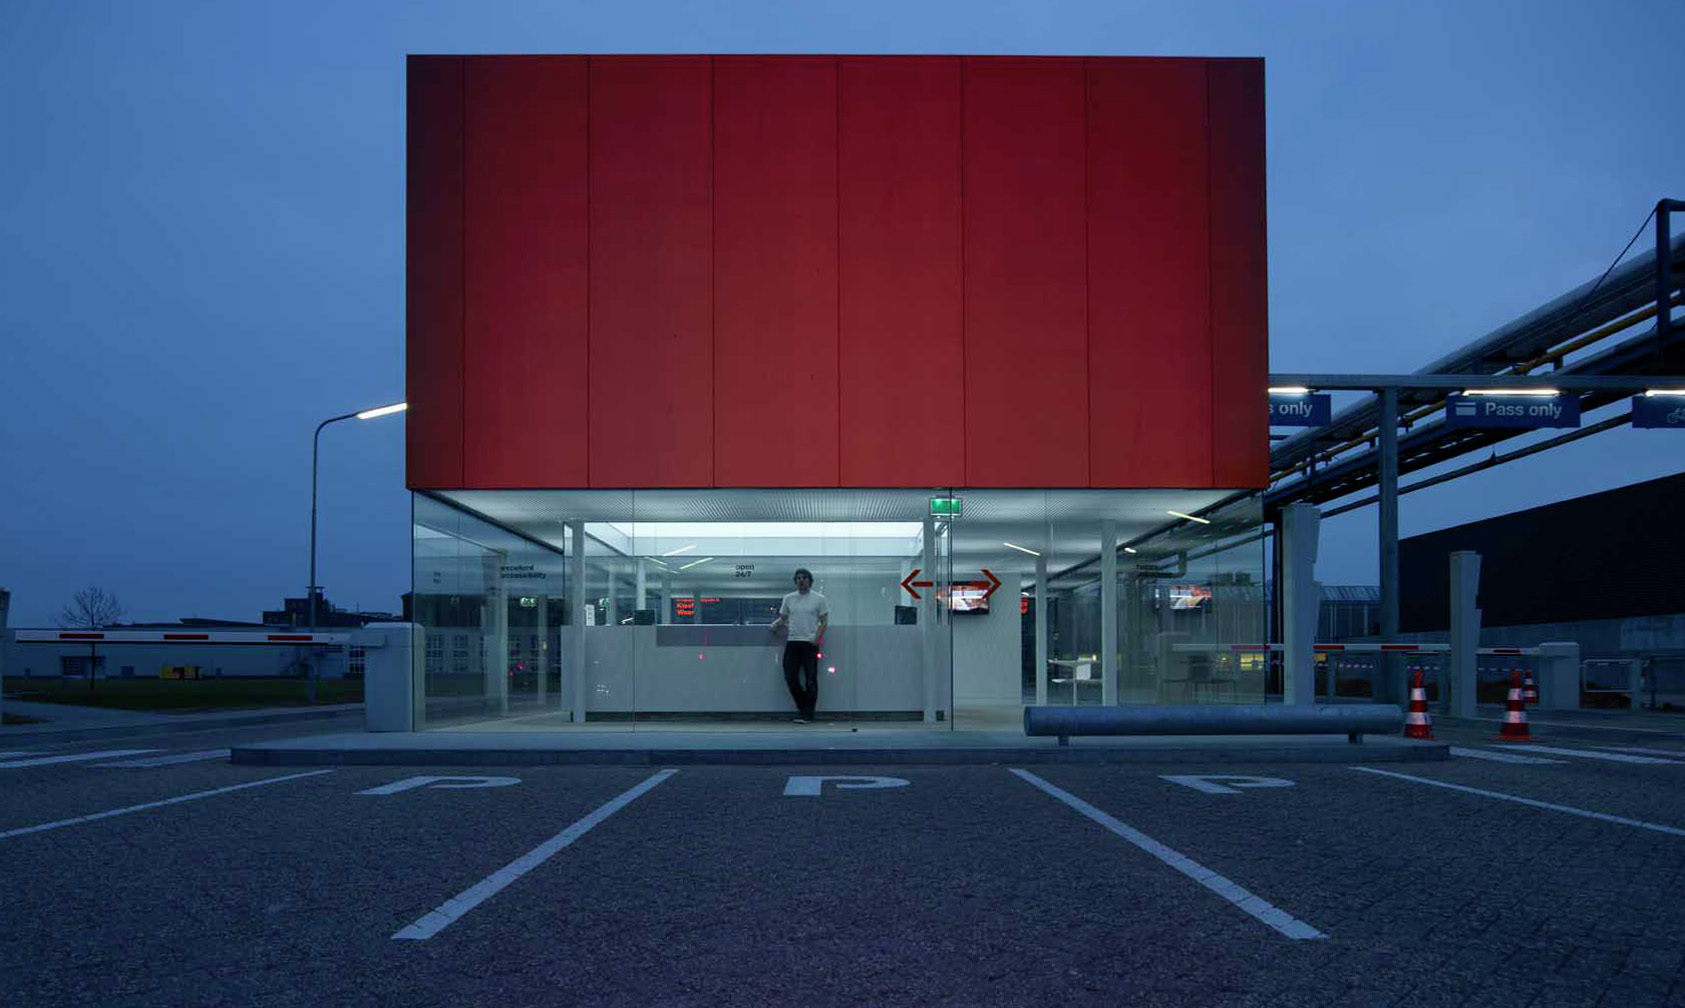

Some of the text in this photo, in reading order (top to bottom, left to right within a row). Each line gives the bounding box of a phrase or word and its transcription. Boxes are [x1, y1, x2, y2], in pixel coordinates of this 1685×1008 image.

[1278, 401, 1313, 418] only
[1486, 402, 1562, 419] Pass only
[735, 563, 755, 571] open
[354, 776, 523, 795] P
[783, 776, 911, 796] P
[1157, 775, 1296, 794] P
